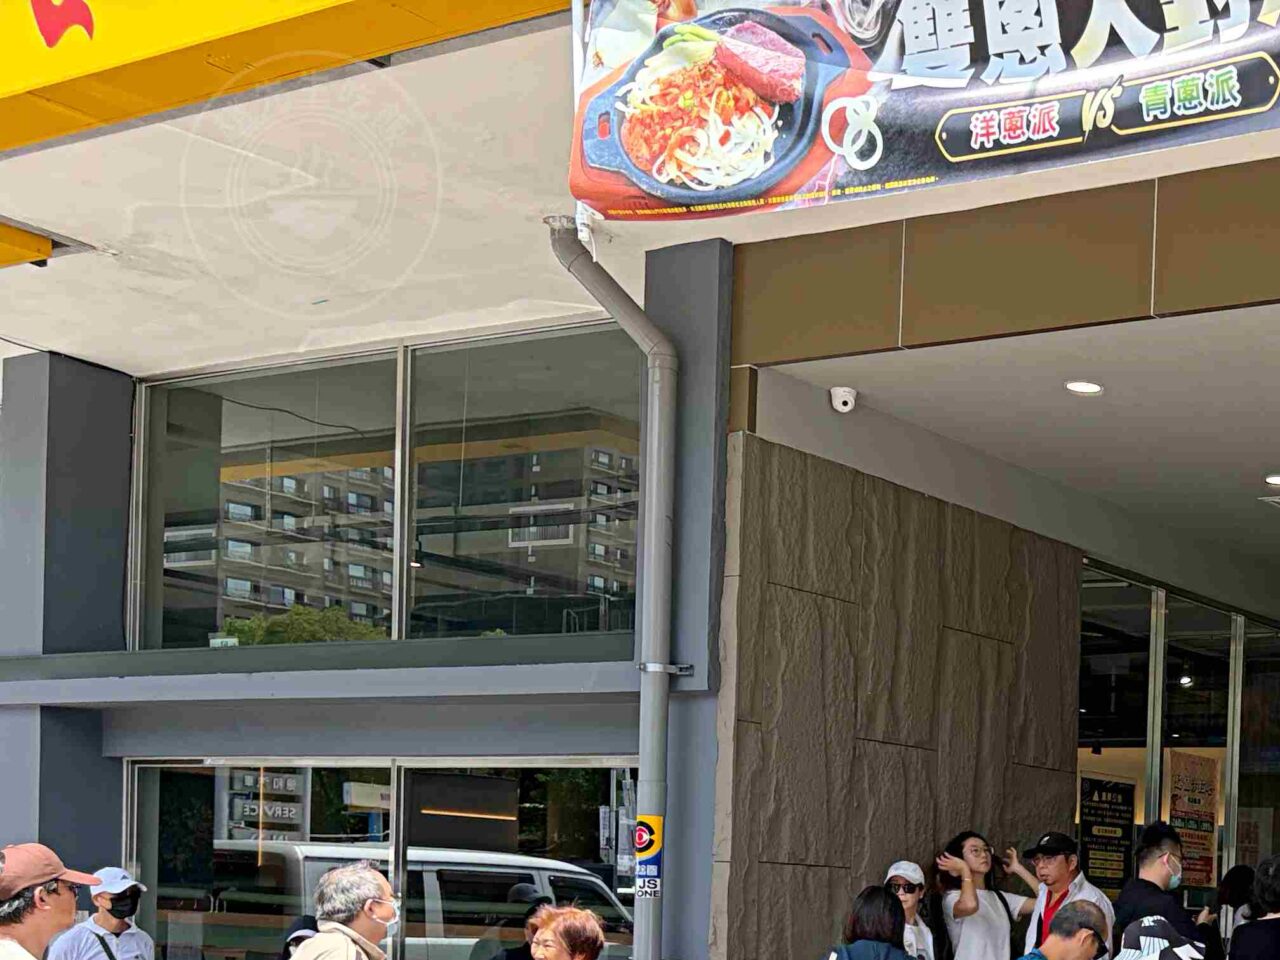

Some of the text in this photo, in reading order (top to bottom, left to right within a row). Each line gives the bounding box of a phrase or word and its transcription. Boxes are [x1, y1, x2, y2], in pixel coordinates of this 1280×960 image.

[1083, 74, 1124, 142] VS
[1139, 65, 1242, 121] 青蔥派
[969, 103, 1060, 149] 洋蔥派
[636, 889, 661, 898] ONE
[638, 878, 658, 890] JS
